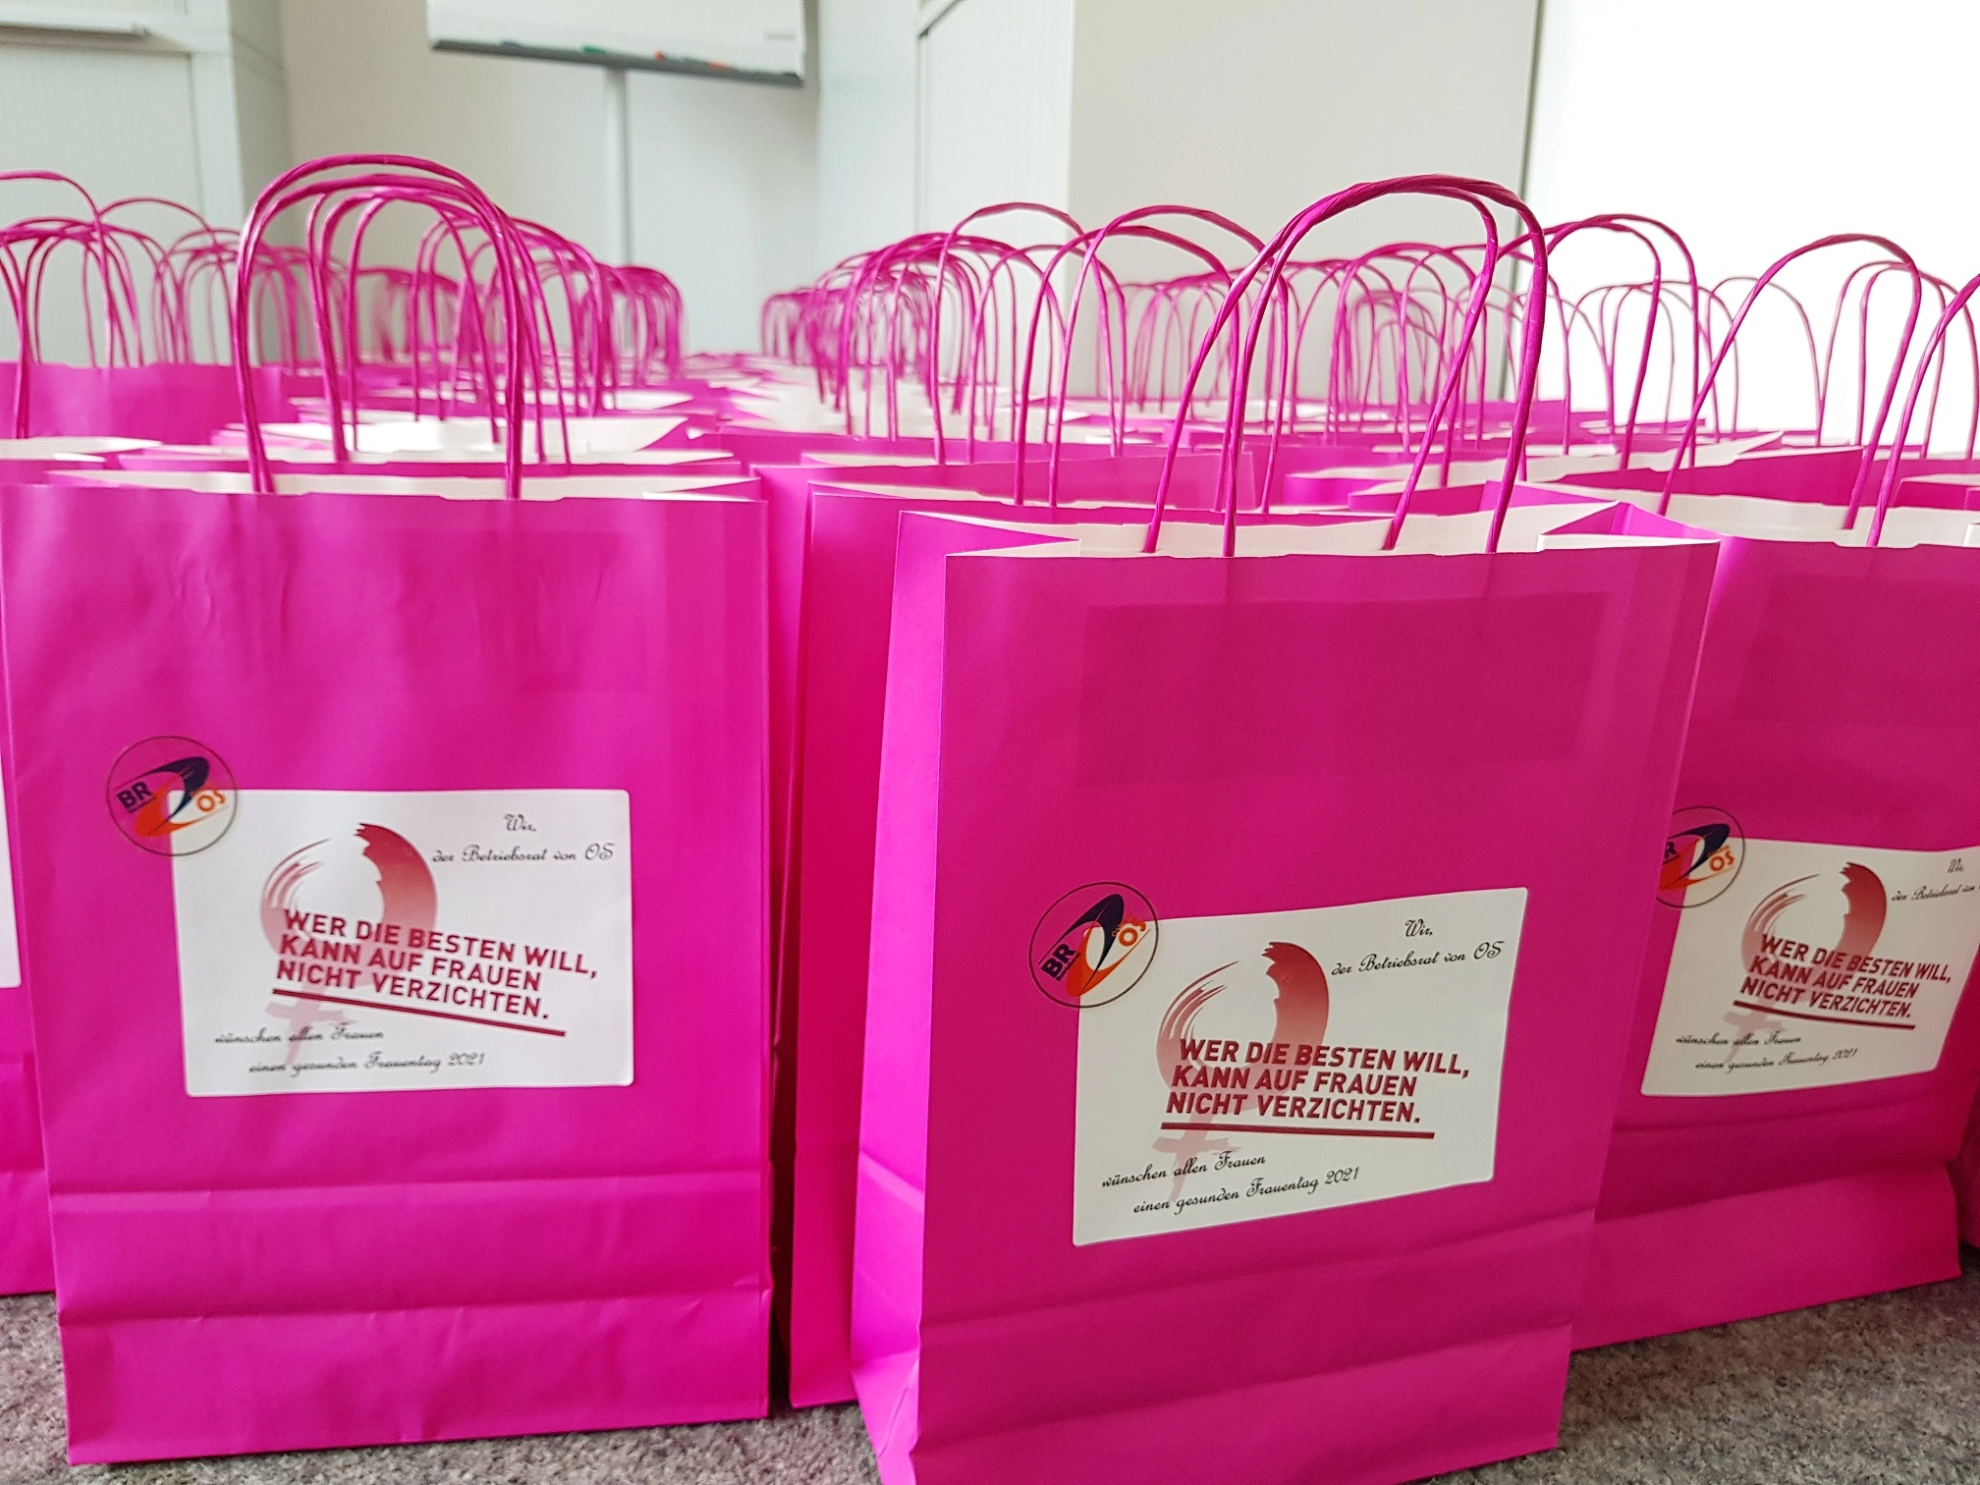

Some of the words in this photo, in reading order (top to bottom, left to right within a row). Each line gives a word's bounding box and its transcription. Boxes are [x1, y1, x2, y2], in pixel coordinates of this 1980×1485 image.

[117, 781, 152, 809] BR
[197, 786, 226, 812] OS
[432, 849, 455, 863] der
[462, 844, 548, 862] Betriebsrat
[552, 850, 577, 861] von
[1709, 850, 1735, 872] OS
[284, 909, 347, 937] WER
[355, 920, 402, 945] DIE
[407, 927, 516, 963] BESTEN
[524, 945, 598, 980] WILL,
[1118, 914, 1146, 947] OS
[1404, 918, 1433, 937] Wir,
[279, 934, 362, 965] KANN
[367, 948, 424, 973] AUF
[431, 956, 542, 991] FRAUEN
[1041, 943, 1076, 979] BR
[1331, 962, 1352, 976] der
[1358, 950, 1440, 972] Betriebsrat
[1444, 952, 1466, 963] von
[1473, 940, 1505, 960] OS
[1760, 934, 1809, 962] WER
[1812, 948, 1846, 969] DIE
[1845, 954, 1914, 978] BESTEN
[1914, 962, 1952, 984] WILL,
[276, 959, 362, 989] NICHT
[372, 972, 549, 1019] VERZICHTEN.
[1748, 955, 1814, 985] KANN
[1812, 970, 1852, 991] AUF
[1852, 976, 1920, 998] FRAUEN
[1740, 976, 1805, 1005] NICHT
[1809, 990, 1912, 1018] VERZICHTEN.
[448, 1053, 485, 1067] 2021
[1180, 1038, 1239, 1063] WER
[1245, 1041, 1290, 1066] DIE
[1294, 1044, 1396, 1070] BESTEN
[1402, 1051, 1470, 1080] WILL,
[1171, 1064, 1251, 1090] KANN
[1253, 1068, 1309, 1091] AUF
[1312, 1070, 1417, 1097] FRAUEN
[1166, 1092, 1249, 1116] NICHT
[1256, 1094, 1421, 1123] VERZICHTEN.
[1101, 1163, 1167, 1188] wünschen
[1173, 1157, 1208, 1177] allen
[1214, 1150, 1266, 1171] Frauen
[1133, 1200, 1171, 1213] einen
[1174, 1188, 1240, 1215] gesunden
[1246, 1175, 1319, 1198] Frauentag
[1324, 1166, 1360, 1185] 2021
